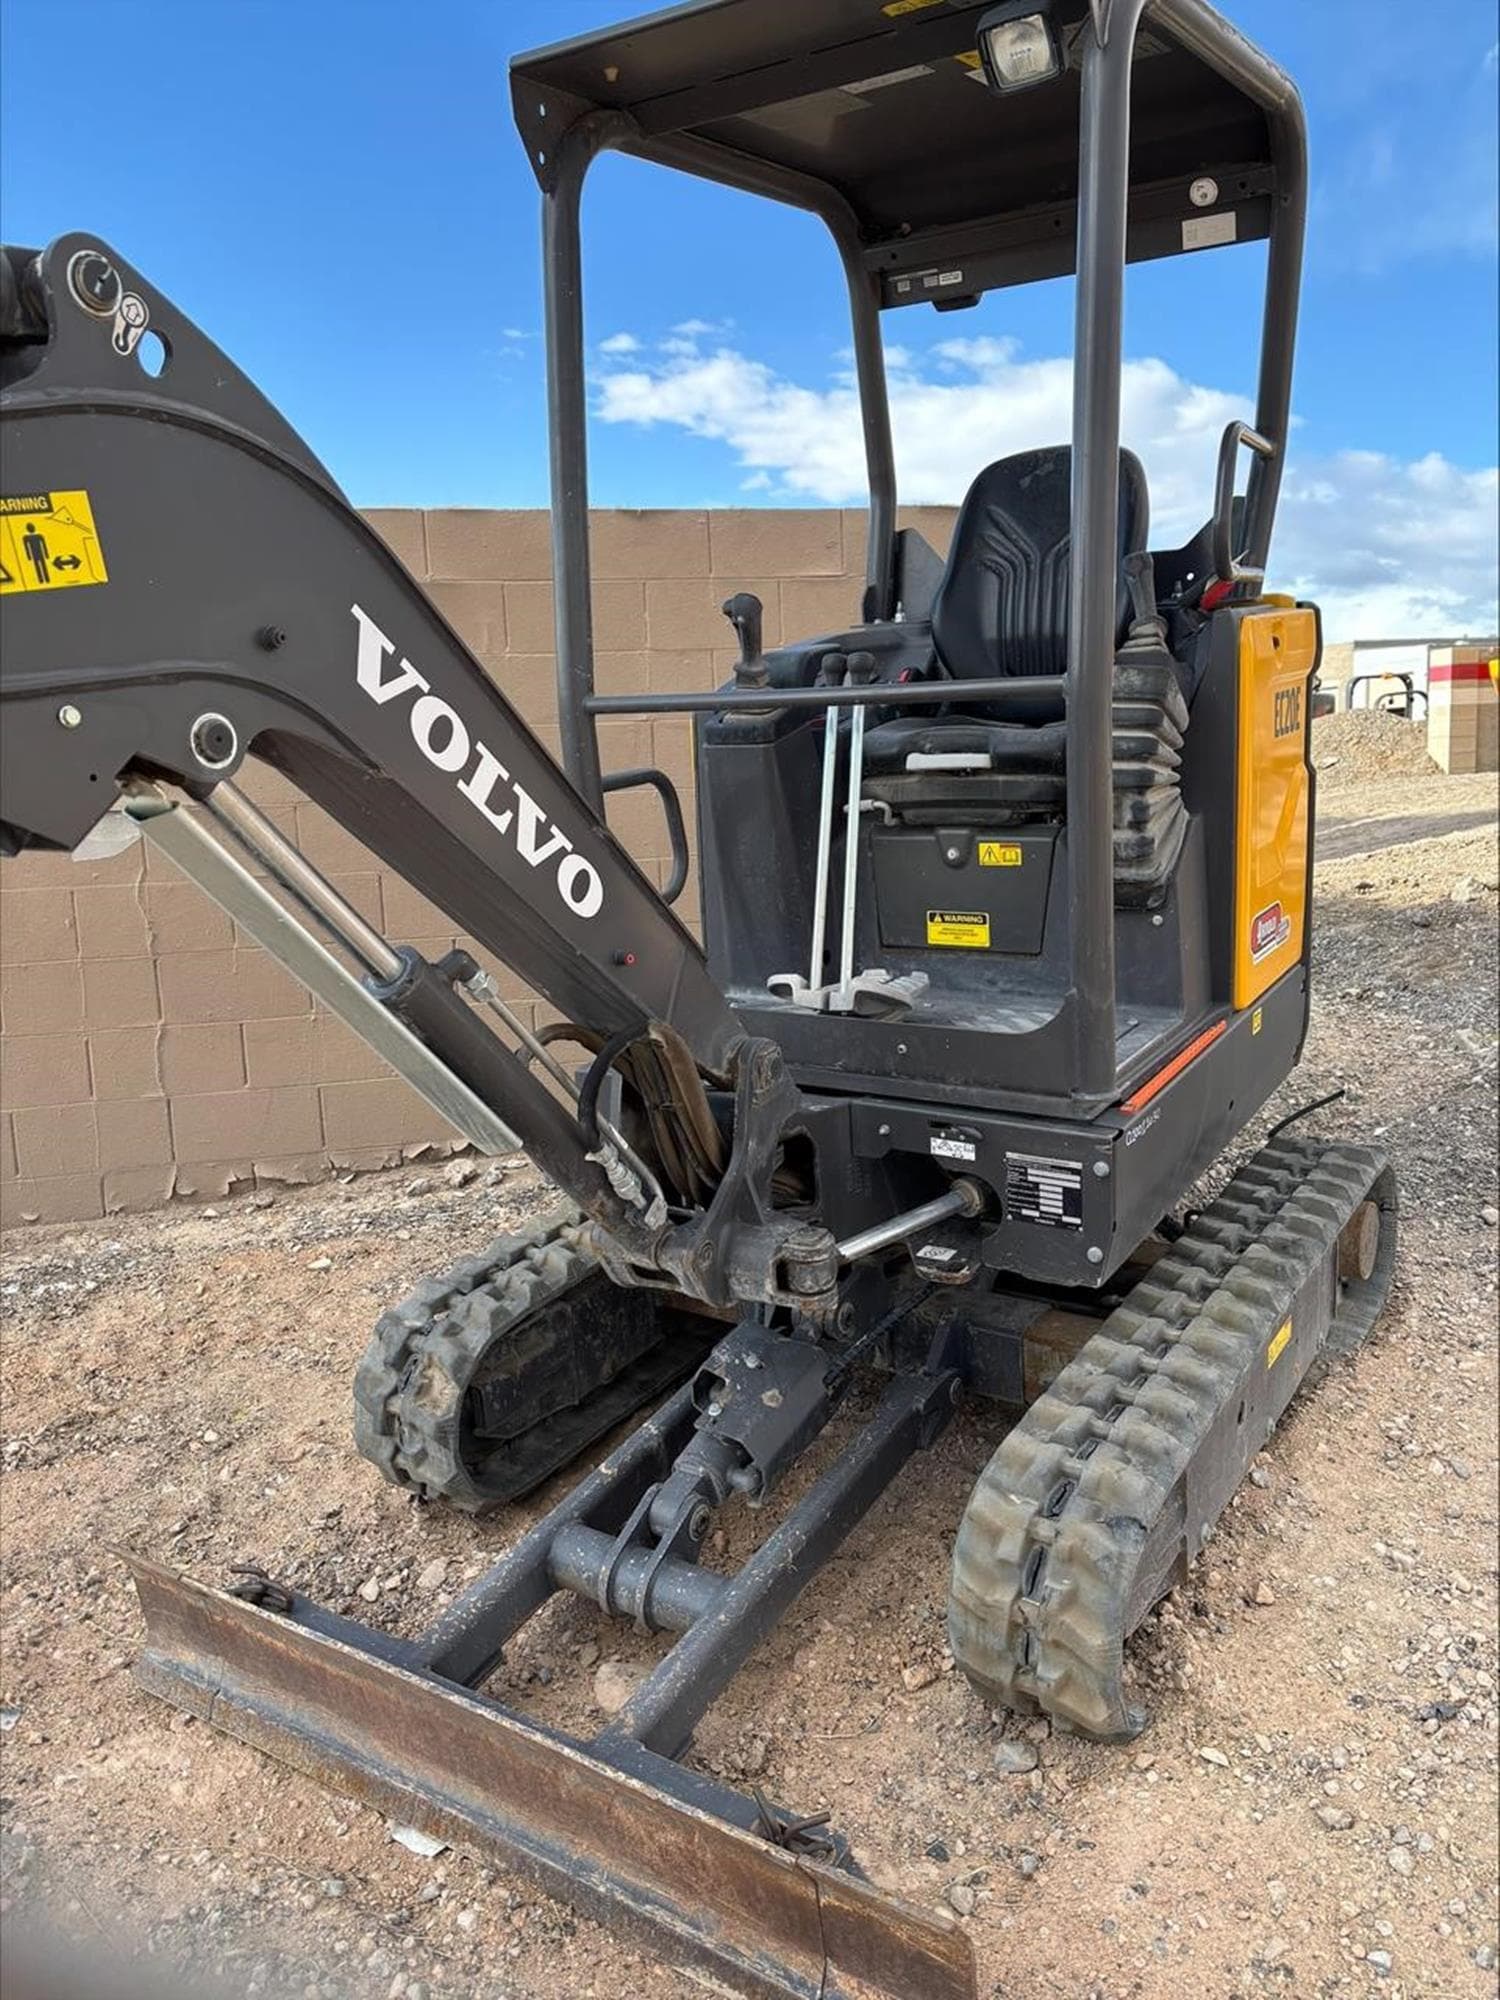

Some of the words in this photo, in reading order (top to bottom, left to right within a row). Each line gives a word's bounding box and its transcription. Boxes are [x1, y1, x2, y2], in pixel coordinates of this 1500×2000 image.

[0, 496, 48, 511] ARNING
[1275, 686, 1301, 738] EC20E
[351, 603, 604, 918] VOLVO
[943, 914, 984, 924] WARNING
